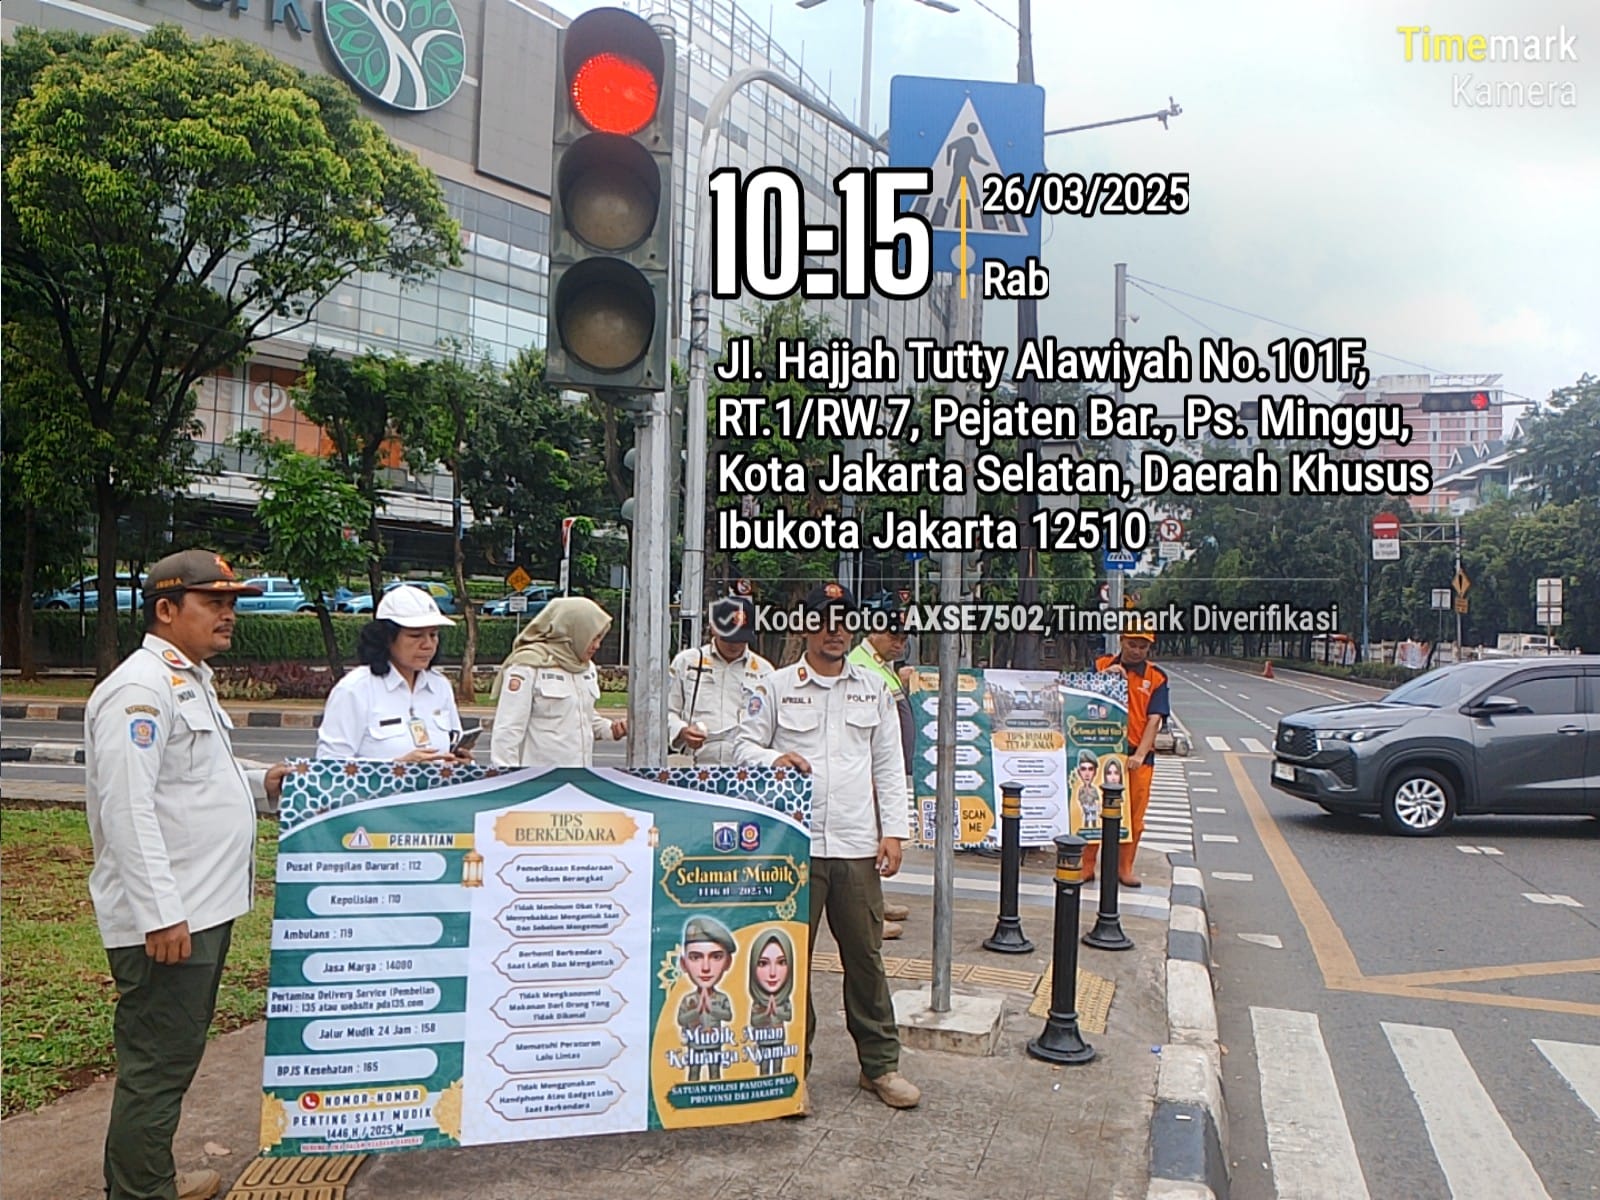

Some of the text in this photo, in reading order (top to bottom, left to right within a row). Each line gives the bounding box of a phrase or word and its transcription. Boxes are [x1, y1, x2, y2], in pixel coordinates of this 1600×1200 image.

[551, 814, 583, 827] TIPS
[962, 810, 986, 820] SCAN
[969, 823, 982, 832] ME
[389, 833, 455, 847] PERHATIAN
[515, 828, 616, 842] BERKENDARA
[286, 862, 313, 872] Pusat
[677, 863, 795, 886] Selamat Mudik
[330, 895, 379, 905] Kepolisian
[284, 930, 330, 940] Ambulans
[323, 963, 344, 973] Jasa
[348, 961, 376, 972] Marga
[319, 1029, 343, 1039] Jalur
[347, 1027, 374, 1038] Mudik
[378, 1026, 390, 1036] 24
[393, 1025, 412, 1035] Jam
[682, 1026, 738, 1046] Mudik
[277, 1065, 300, 1076] BPJS
[304, 1064, 353, 1075] Kesehatan
[672, 1085, 706, 1095] SATUAN
[709, 1082, 738, 1092] POLISI
[293, 1108, 432, 1126] PENTING SAAT MUDIK
[327, 1127, 349, 1138] 1446
[352, 1127, 359, 1137] H
[370, 1125, 393, 1136] 2025
[396, 1124, 404, 1134] M
